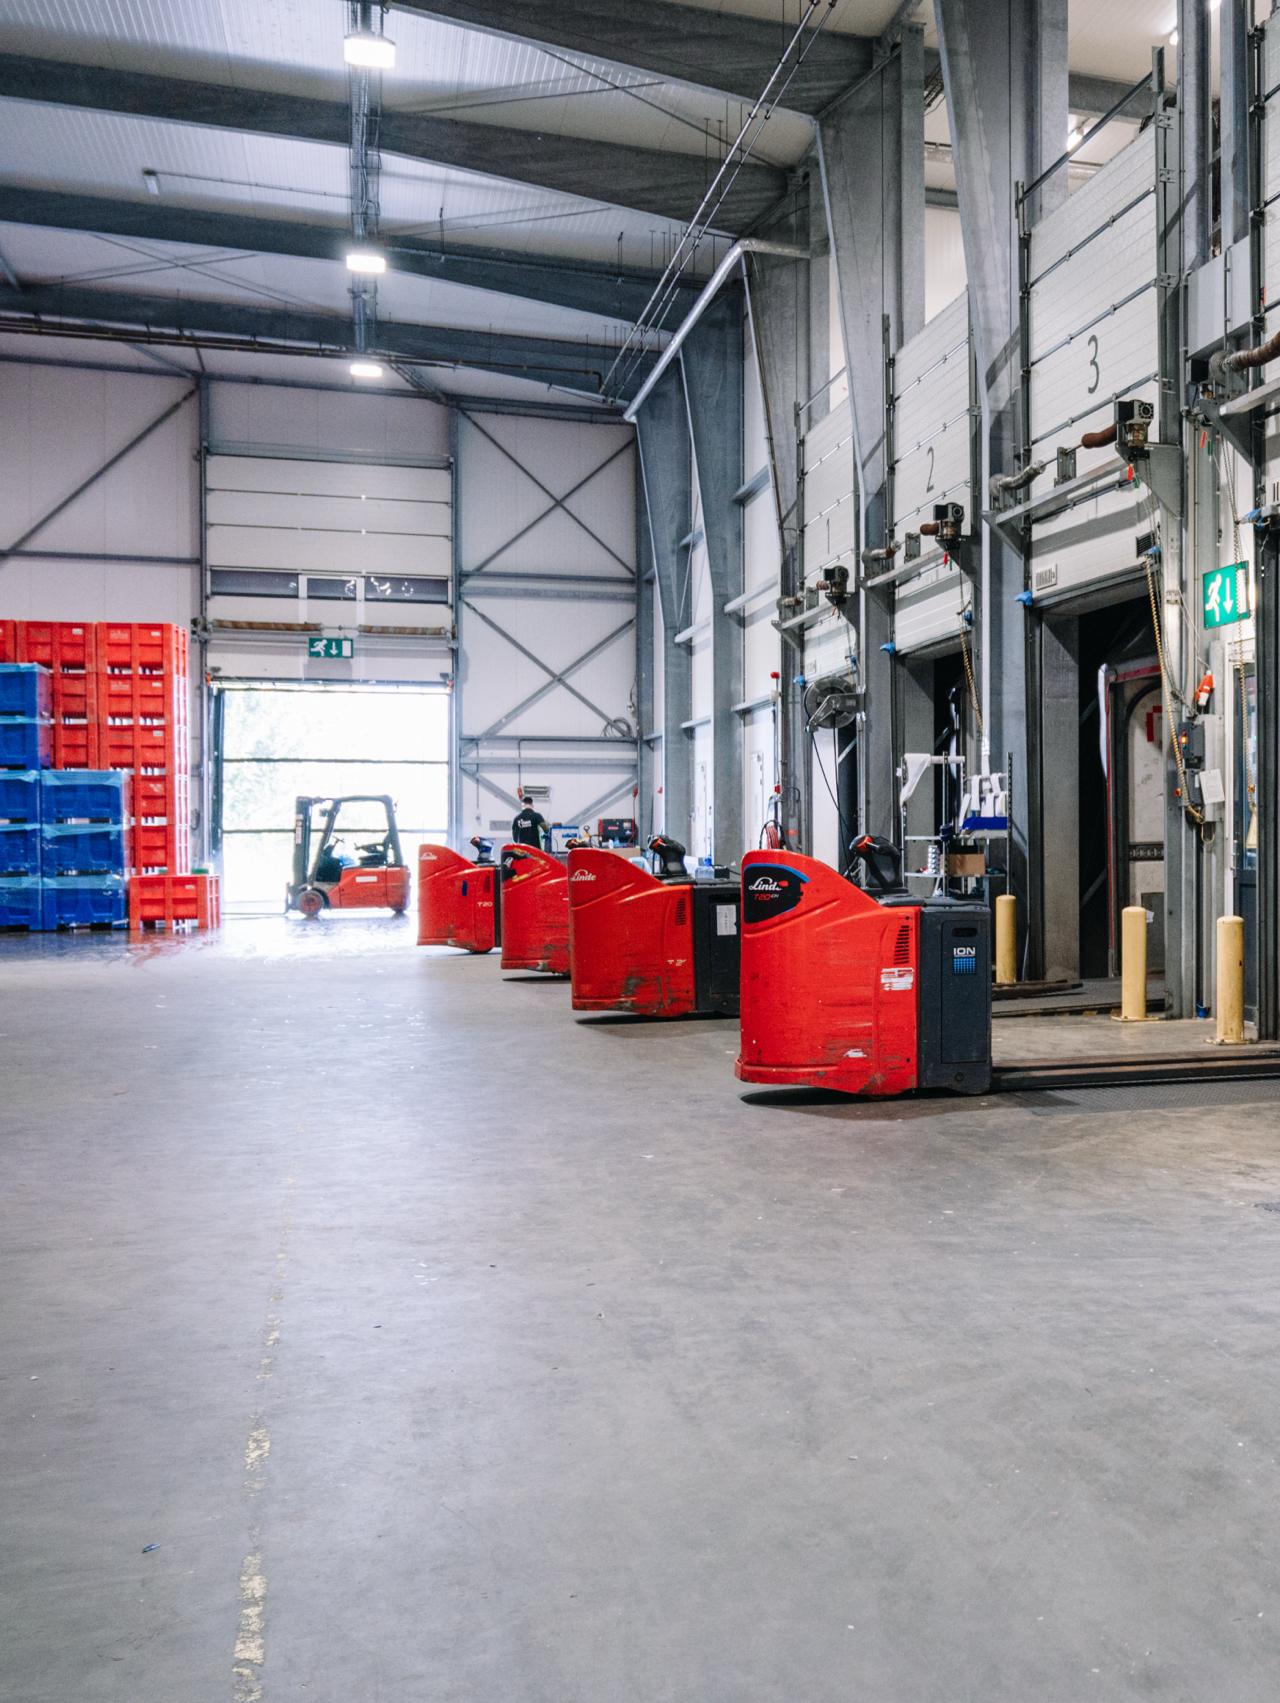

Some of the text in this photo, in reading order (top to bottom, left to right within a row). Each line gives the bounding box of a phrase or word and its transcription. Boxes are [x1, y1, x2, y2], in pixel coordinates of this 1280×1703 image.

[1088, 335, 1099, 393] 3
[927, 446, 934, 493] 2
[953, 946, 976, 955] ION
